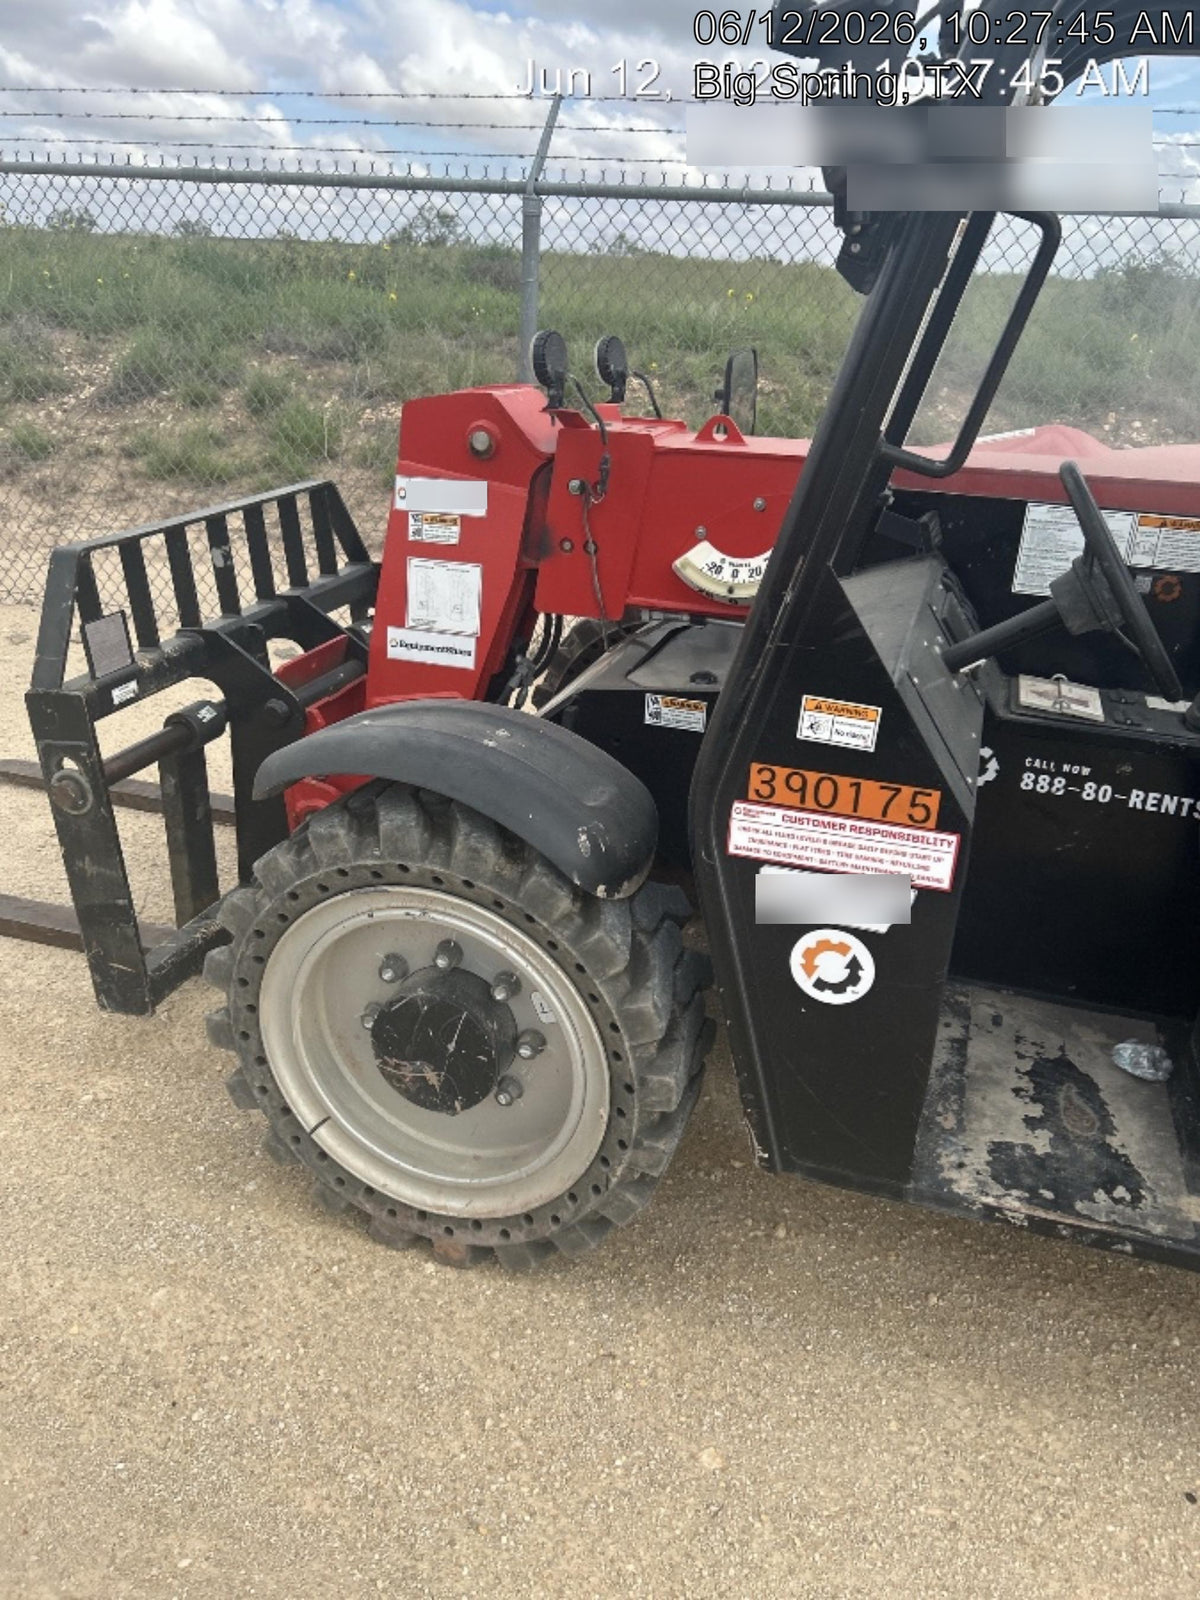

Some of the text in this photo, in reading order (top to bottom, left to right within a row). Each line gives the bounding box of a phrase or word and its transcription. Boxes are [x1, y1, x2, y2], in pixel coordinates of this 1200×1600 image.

[731, 568, 739, 579] 0
[748, 566, 762, 578] 20
[824, 703, 869, 718] WARNING
[834, 728, 845, 737] No
[1025, 757, 1092, 776] CALL NOW
[753, 766, 933, 825] 390175
[1020, 771, 1200, 820] 888-80-RENTS
[781, 813, 955, 848] CUSTOMER RESPONSIBILITY
